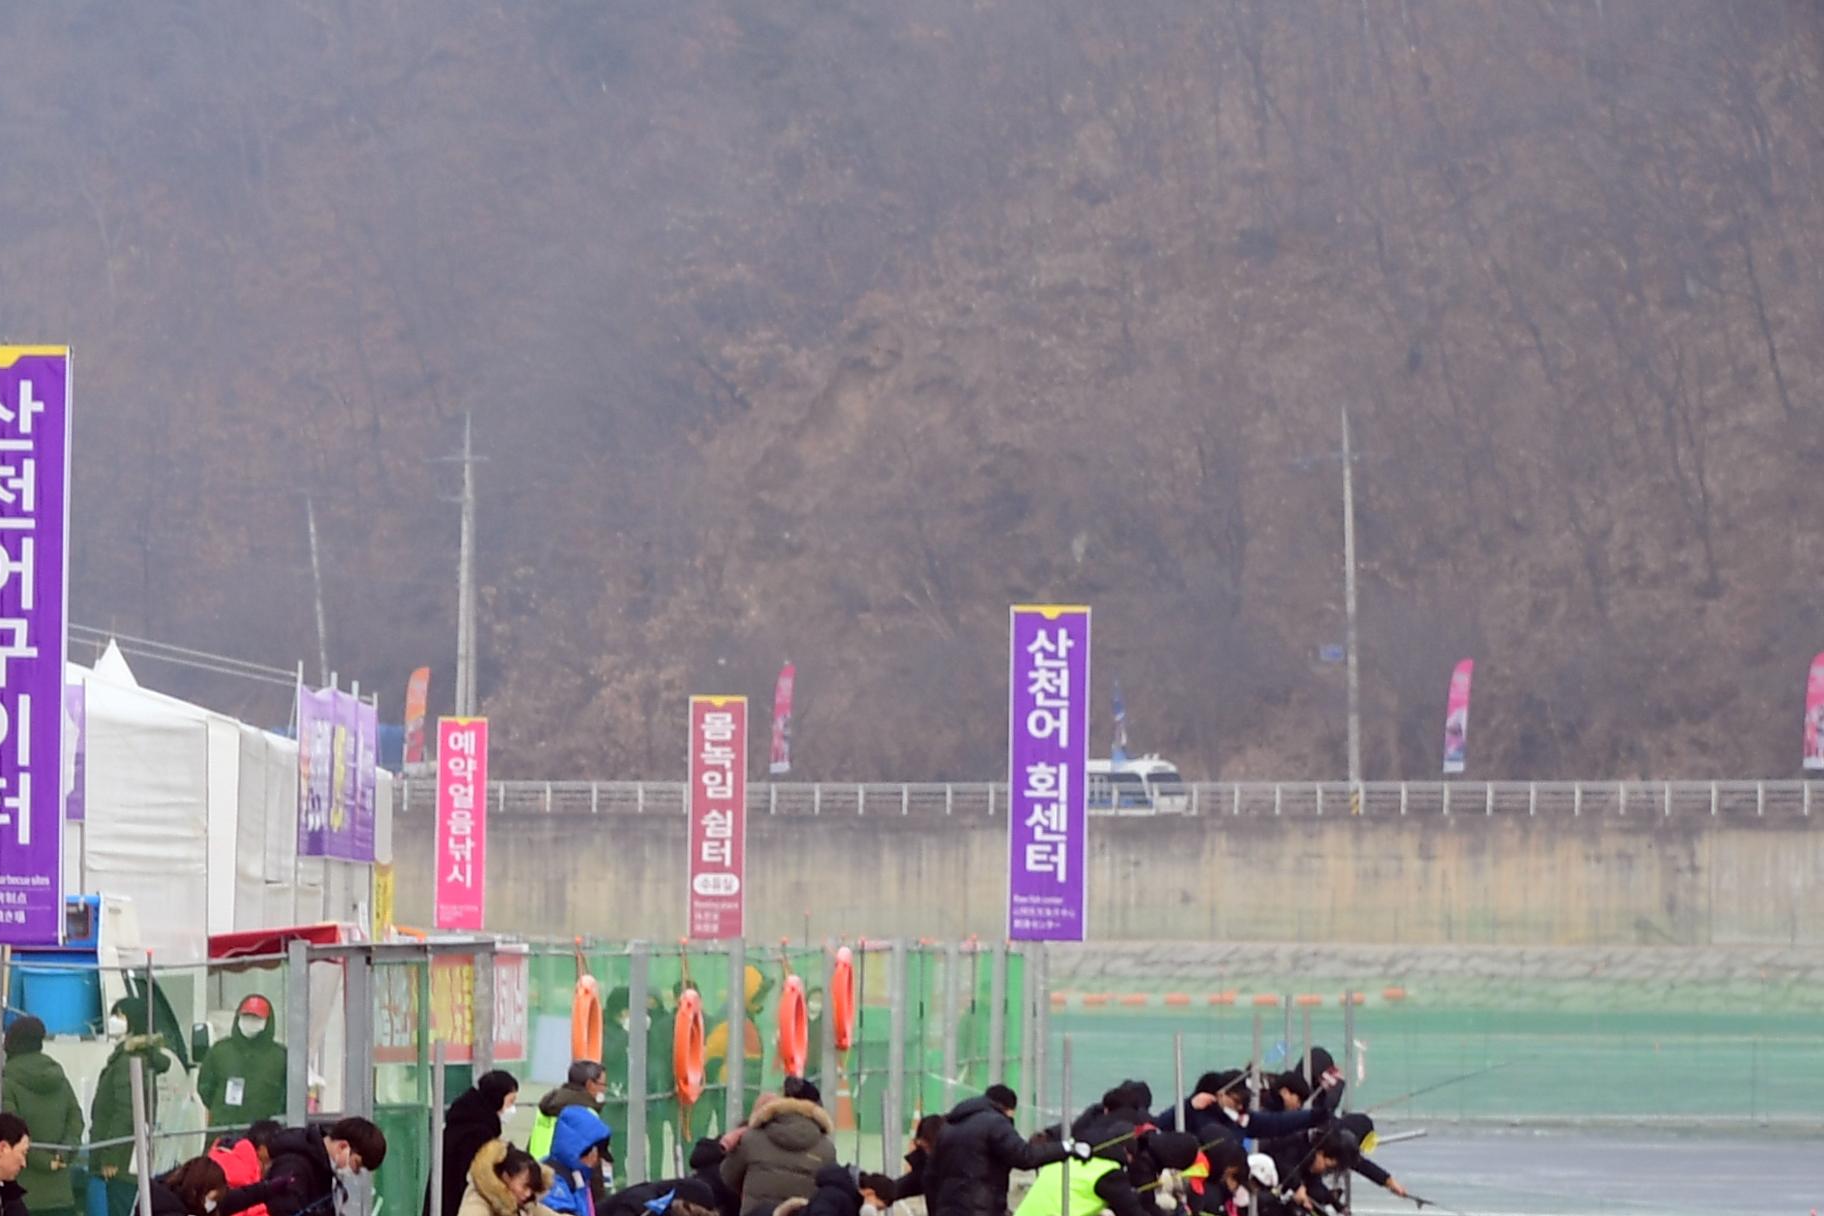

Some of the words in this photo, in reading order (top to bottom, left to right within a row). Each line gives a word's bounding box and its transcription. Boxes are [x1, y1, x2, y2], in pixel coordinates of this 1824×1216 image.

[1026, 628, 1074, 748] 산천어
[447, 730, 477, 888] 예약얼음낚시
[701, 712, 735, 800] 몸녹임
[701, 809, 734, 867] 쉼터
[1024, 762, 1069, 883] 회센터
